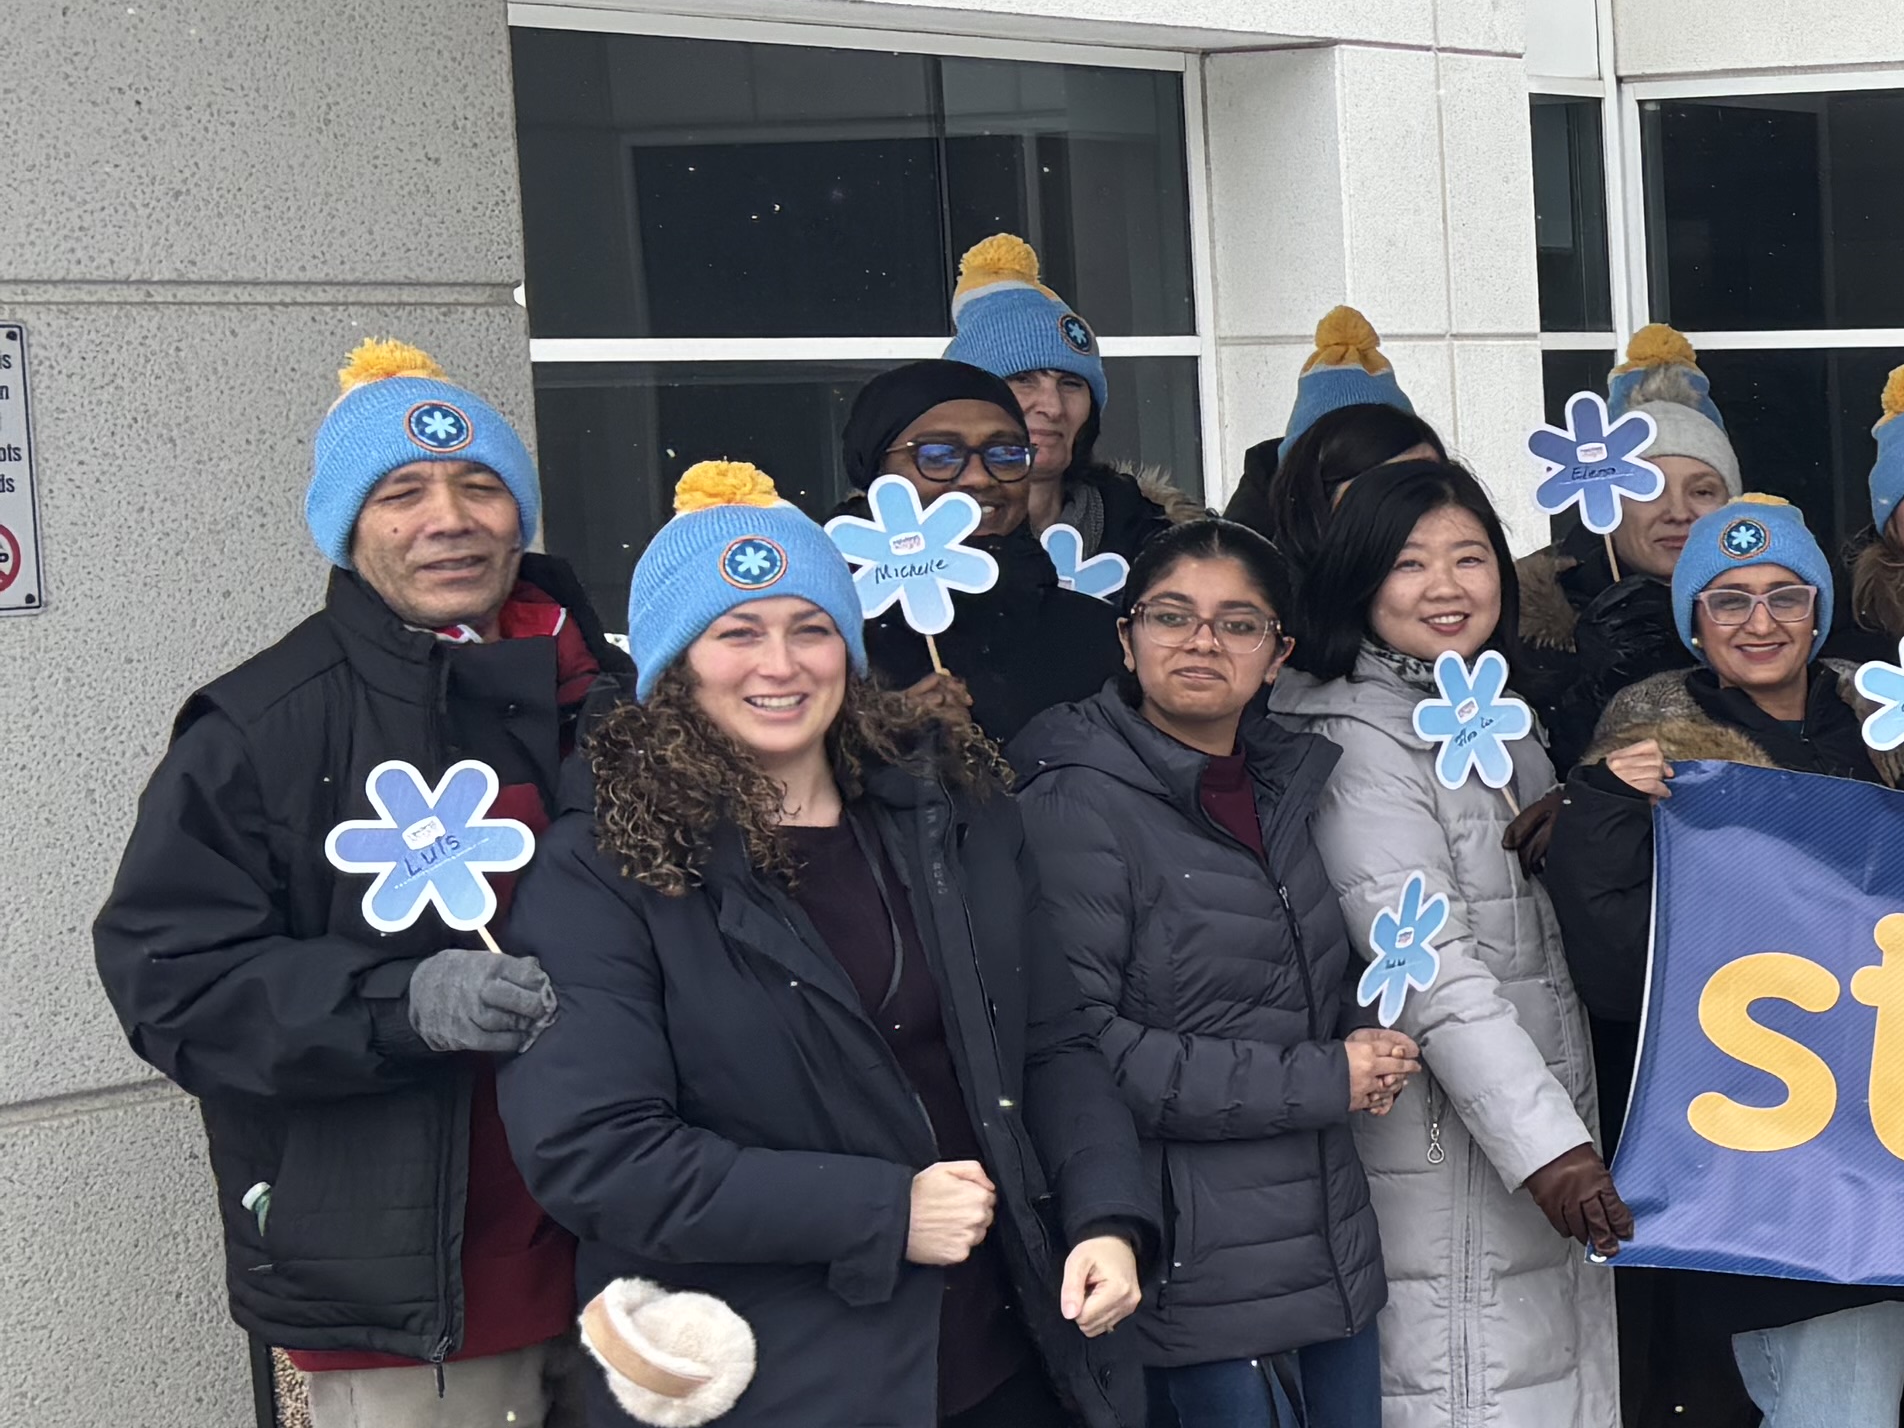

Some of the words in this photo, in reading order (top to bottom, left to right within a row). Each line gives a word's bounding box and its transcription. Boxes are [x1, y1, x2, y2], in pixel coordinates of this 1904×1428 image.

[0, 443, 22, 462] ots
[875, 558, 949, 584] Michelle
[404, 835, 461, 876] Luis
